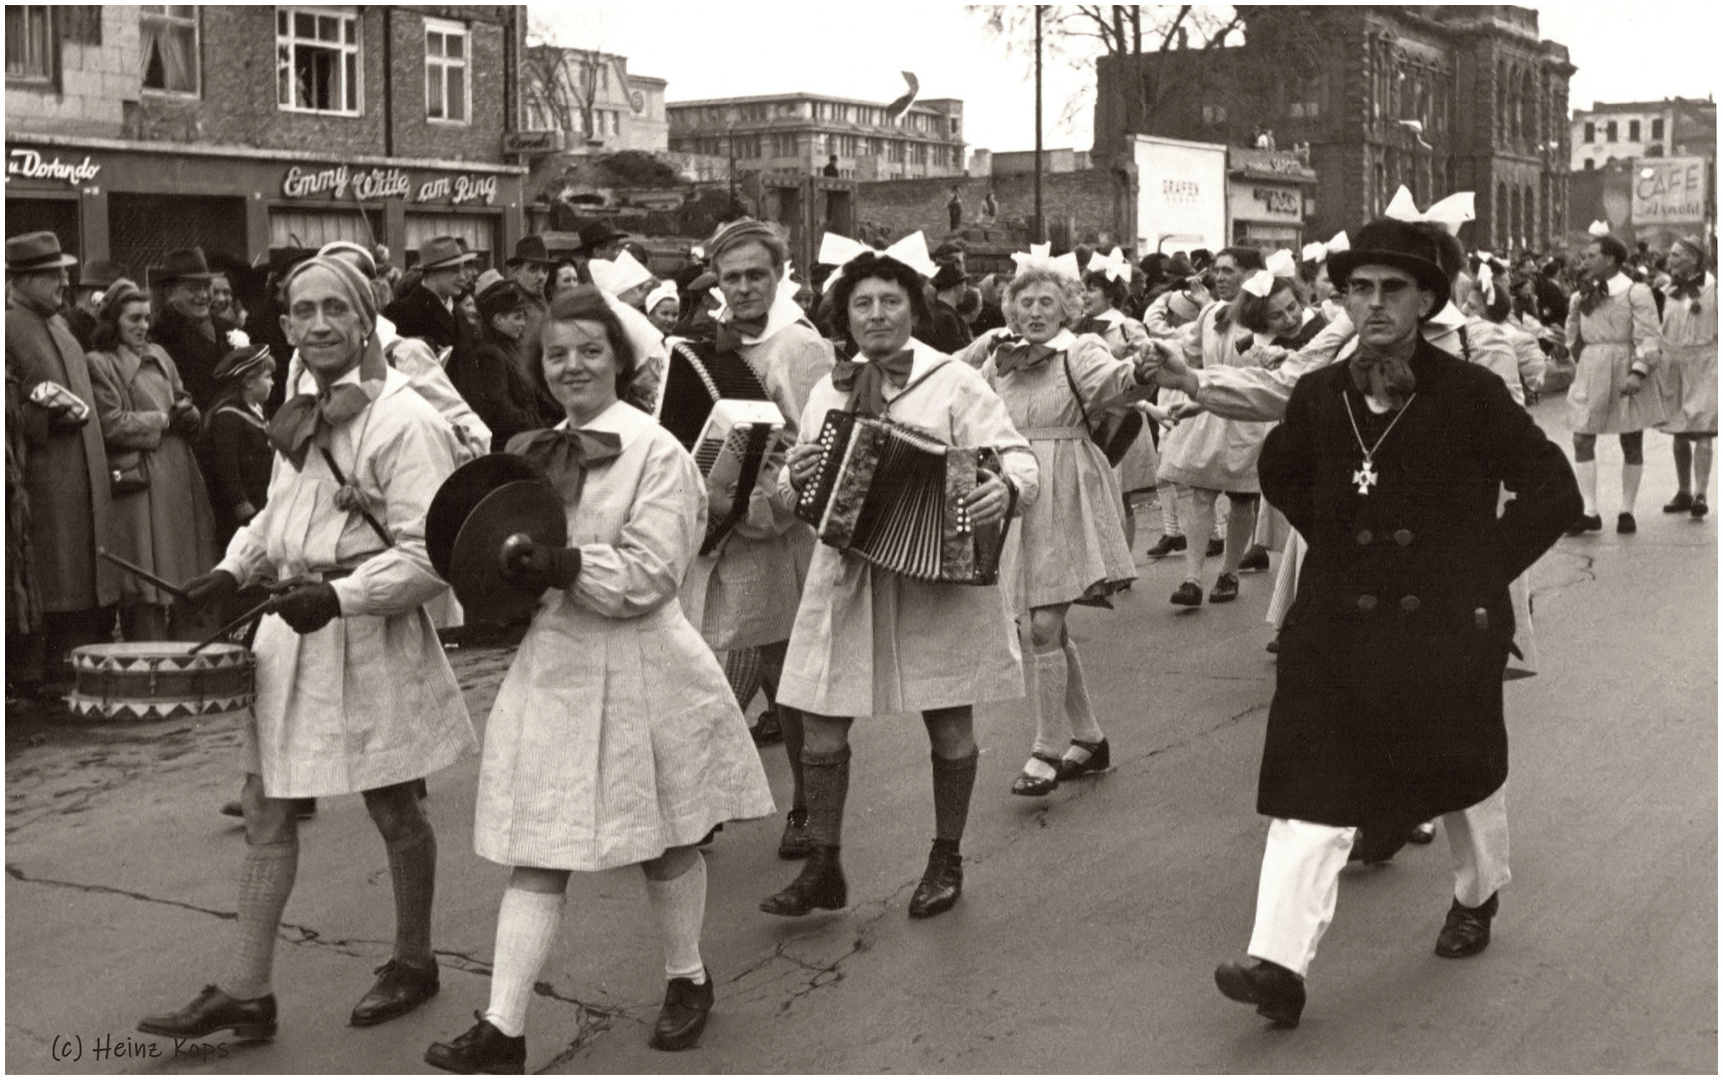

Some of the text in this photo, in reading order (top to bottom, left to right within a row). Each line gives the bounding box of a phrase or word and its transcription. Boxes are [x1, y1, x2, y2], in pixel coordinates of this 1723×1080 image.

[284, 165, 349, 199] Emmy
[417, 176, 451, 202] am
[452, 173, 498, 205] Ring
